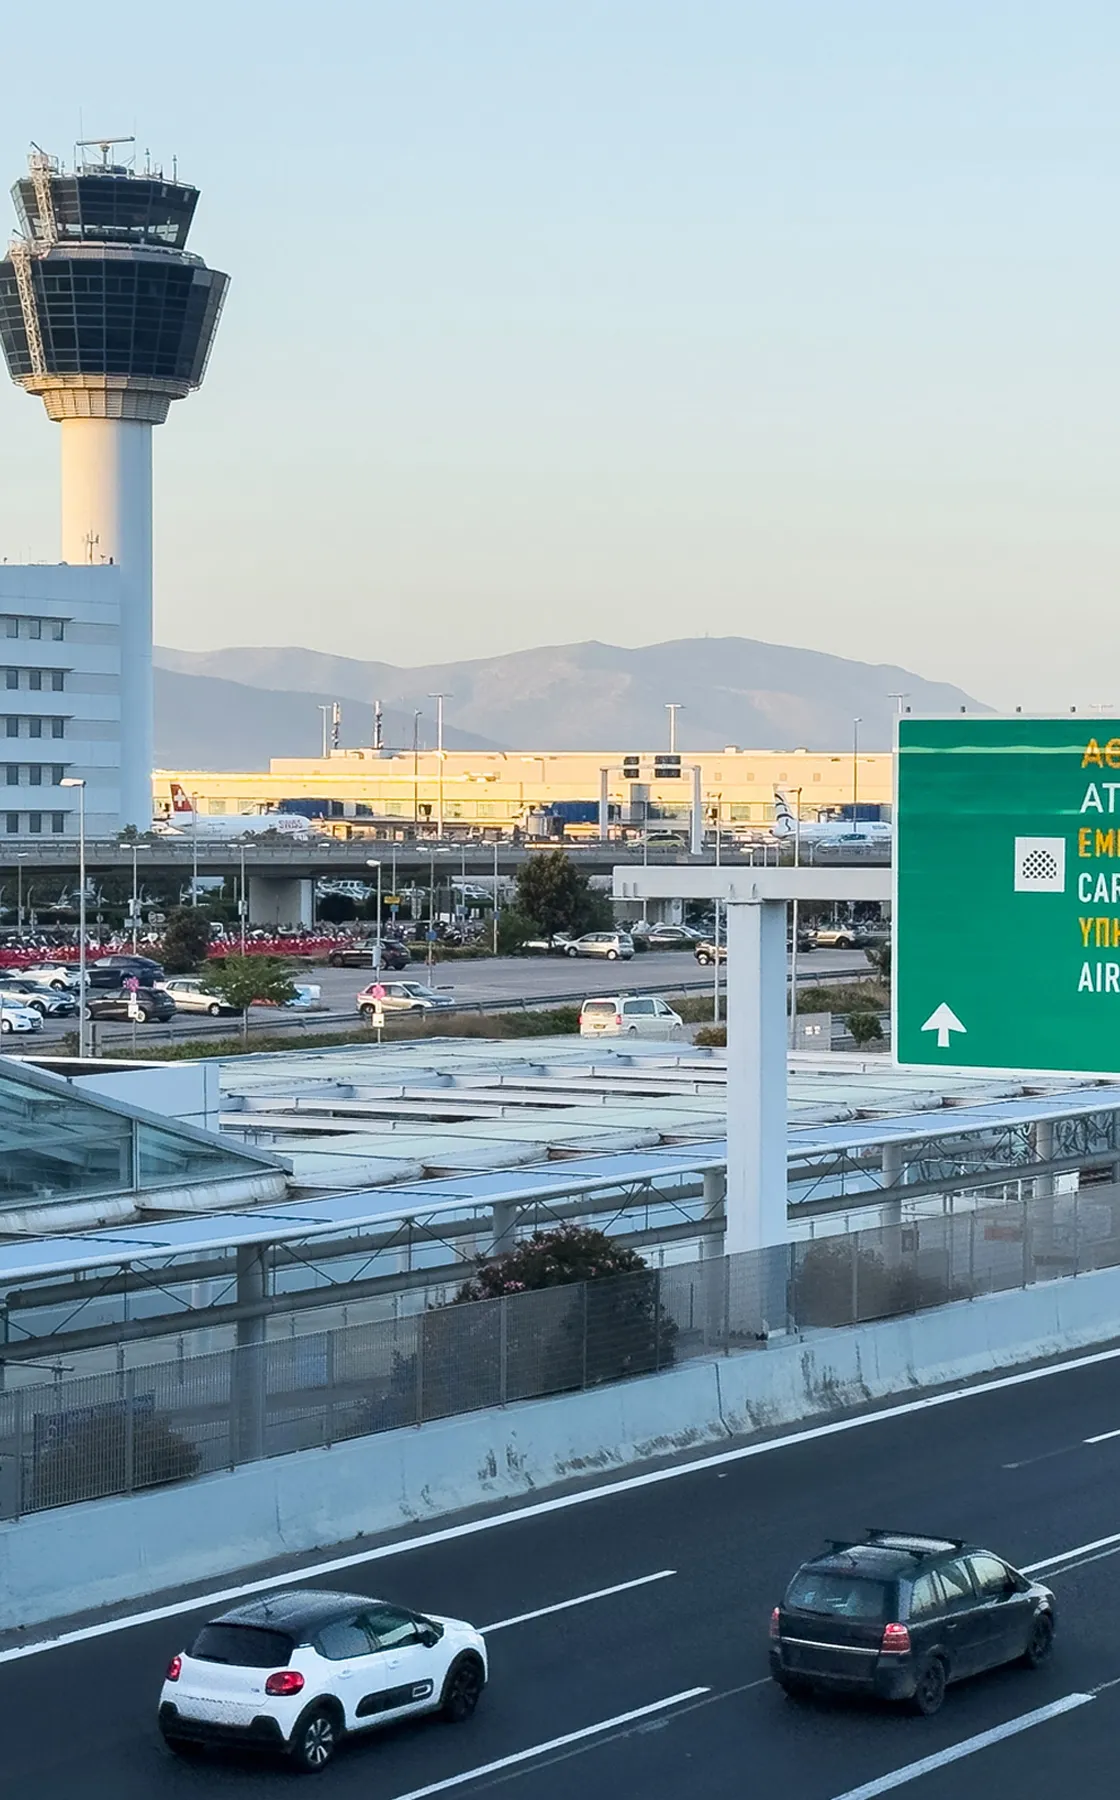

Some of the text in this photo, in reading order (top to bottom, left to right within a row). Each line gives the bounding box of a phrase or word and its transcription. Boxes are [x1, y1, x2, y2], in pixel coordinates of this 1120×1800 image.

[1080, 783, 1120, 813] AT
[1079, 828, 1120, 857] ΕΜ
[1078, 962, 1120, 993] AIR
